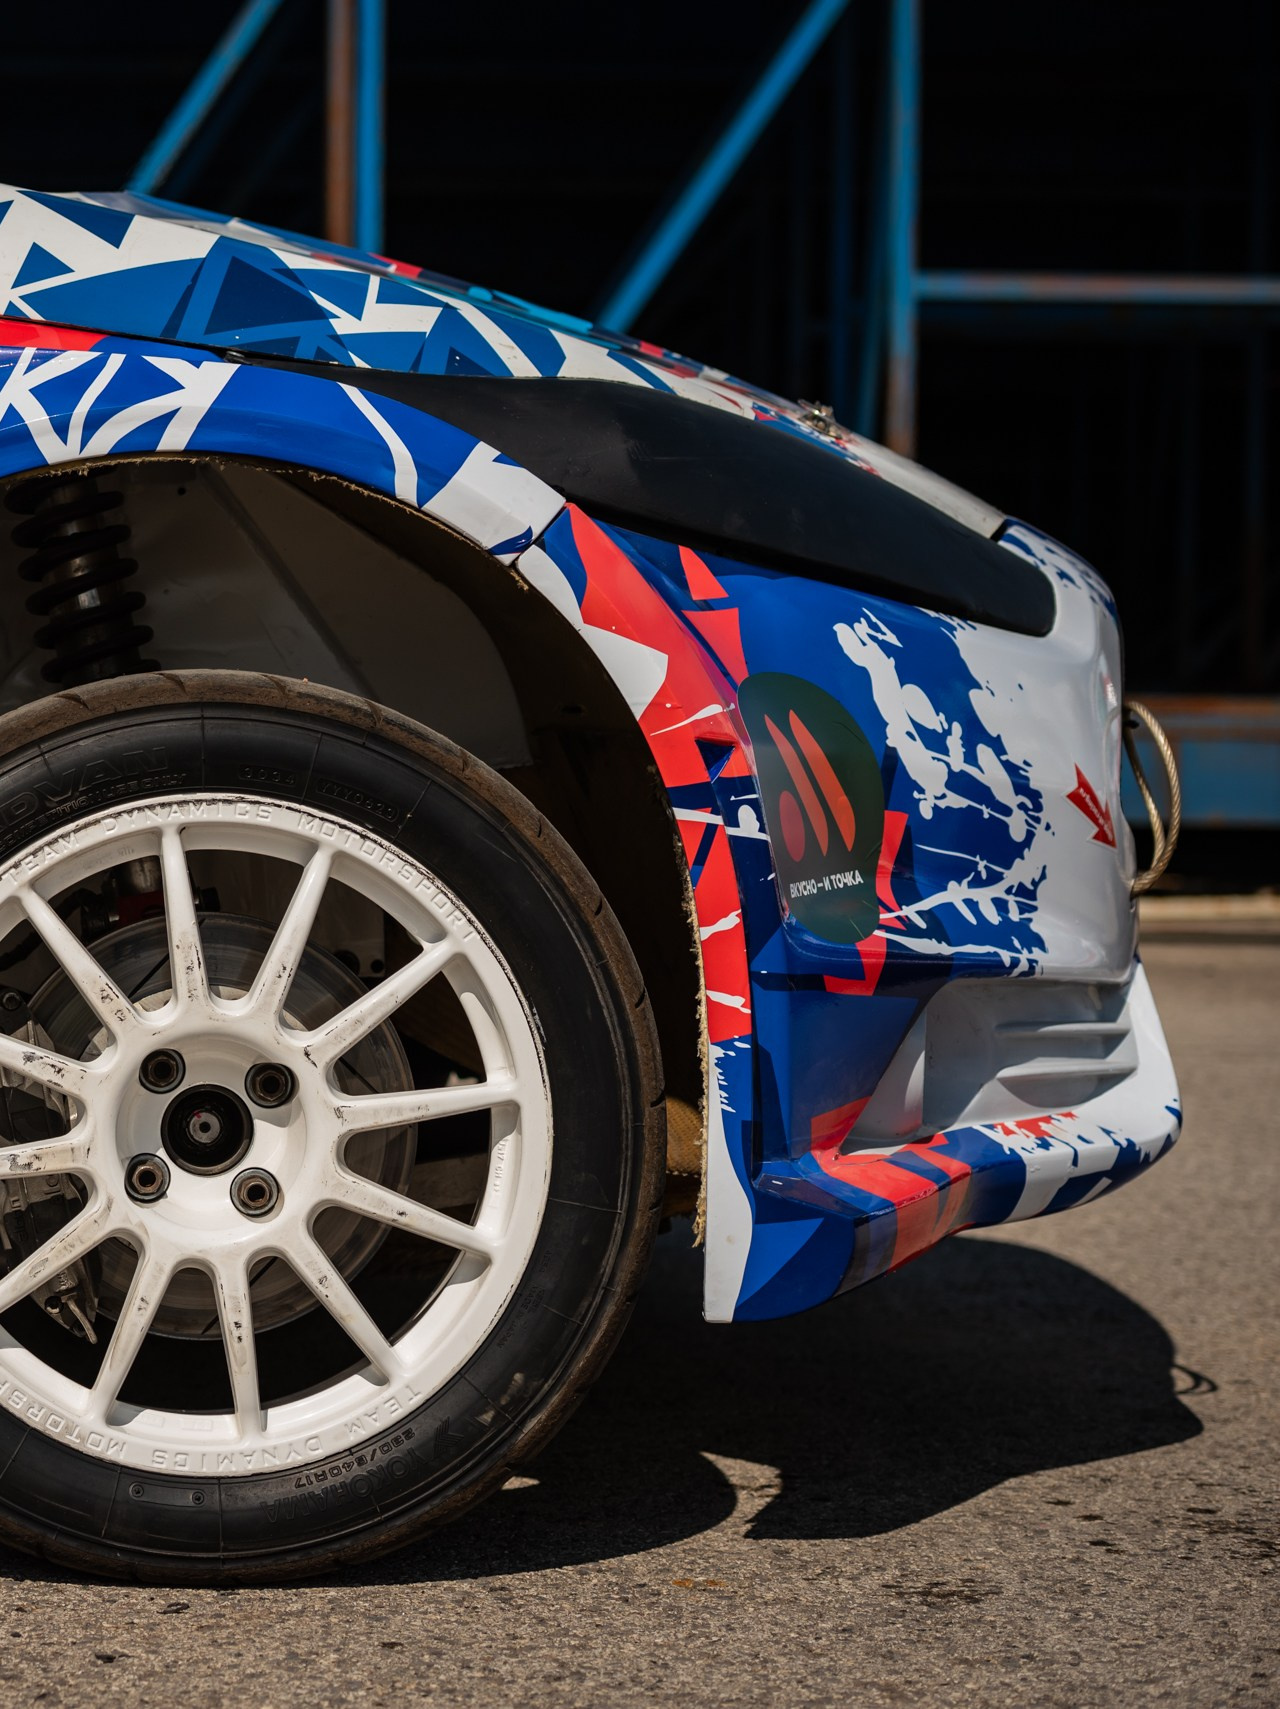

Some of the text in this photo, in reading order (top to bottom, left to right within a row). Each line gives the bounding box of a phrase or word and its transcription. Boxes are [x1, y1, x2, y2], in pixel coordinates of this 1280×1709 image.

[142, 773, 187, 790] ONLY
[1, 830, 81, 886] TEAM
[101, 799, 273, 836] DYNAMICS
[298, 812, 480, 942] MOTORSPORT
[789, 878, 818, 898] ВКУСНО
[830, 869, 865, 890] ТОЧКА
[343, 1385, 423, 1435] TEAM
[151, 1436, 323, 1470] DYNAMICS
[294, 1427, 415, 1489] 230/640R17
[260, 1446, 429, 1523] YOKOHAMA
